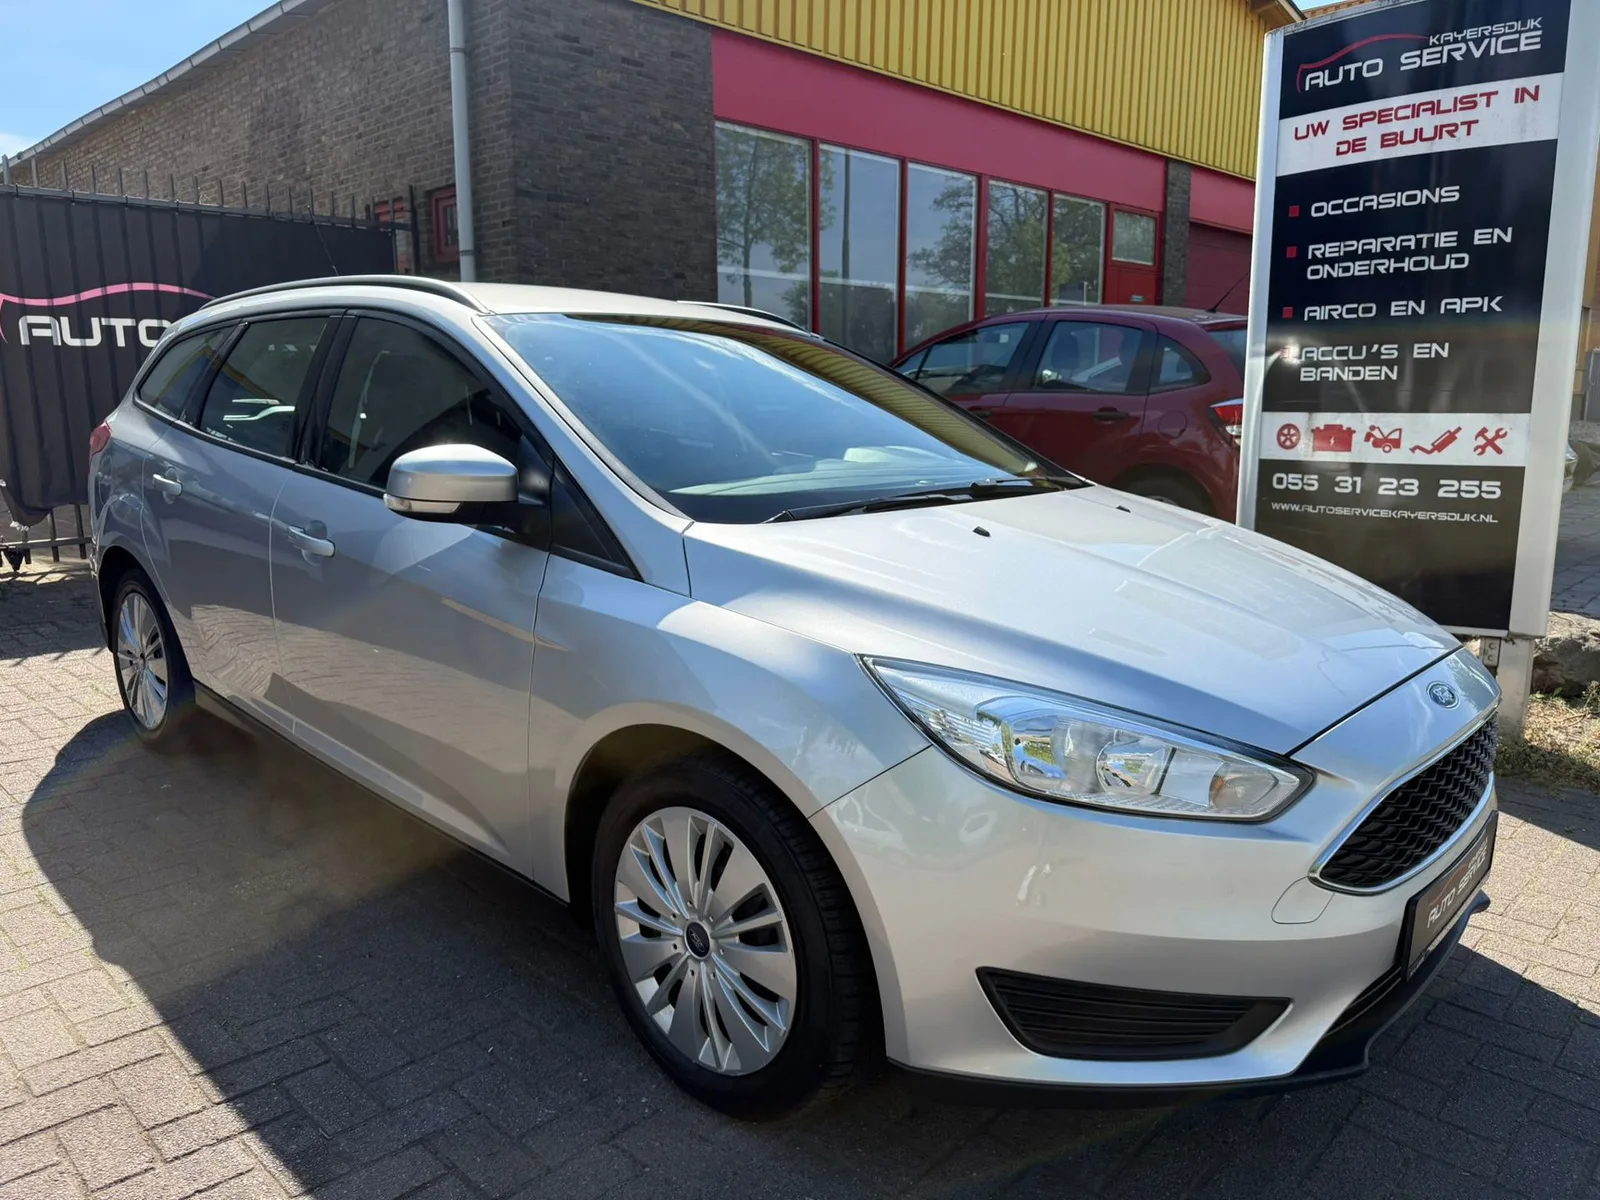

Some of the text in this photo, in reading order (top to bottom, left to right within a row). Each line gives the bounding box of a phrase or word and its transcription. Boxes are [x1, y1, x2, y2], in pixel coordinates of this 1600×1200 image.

[1429, 17, 1543, 45] KAYERSDIJK
[1304, 30, 1543, 92] AUTO SERVICE
[1294, 85, 1541, 141] UW SPECIALIST IN
[1335, 119, 1480, 157] DE BUURT
[1310, 185, 1461, 218] OCCASIONS
[1307, 227, 1514, 260] REPARATIE EN
[1306, 252, 1470, 281] ONDERHOUD
[1303, 295, 1504, 322] AIRCO EN APK
[18, 315, 173, 348] AUTO
[1300, 342, 1450, 362] ACCU'S EN
[1299, 365, 1399, 383] BANDEN
[1271, 472, 1502, 500] 055 31 23 255
[1271, 502, 1499, 525] WWW.AUTOSERVICEKAYERSDIJK.NL
